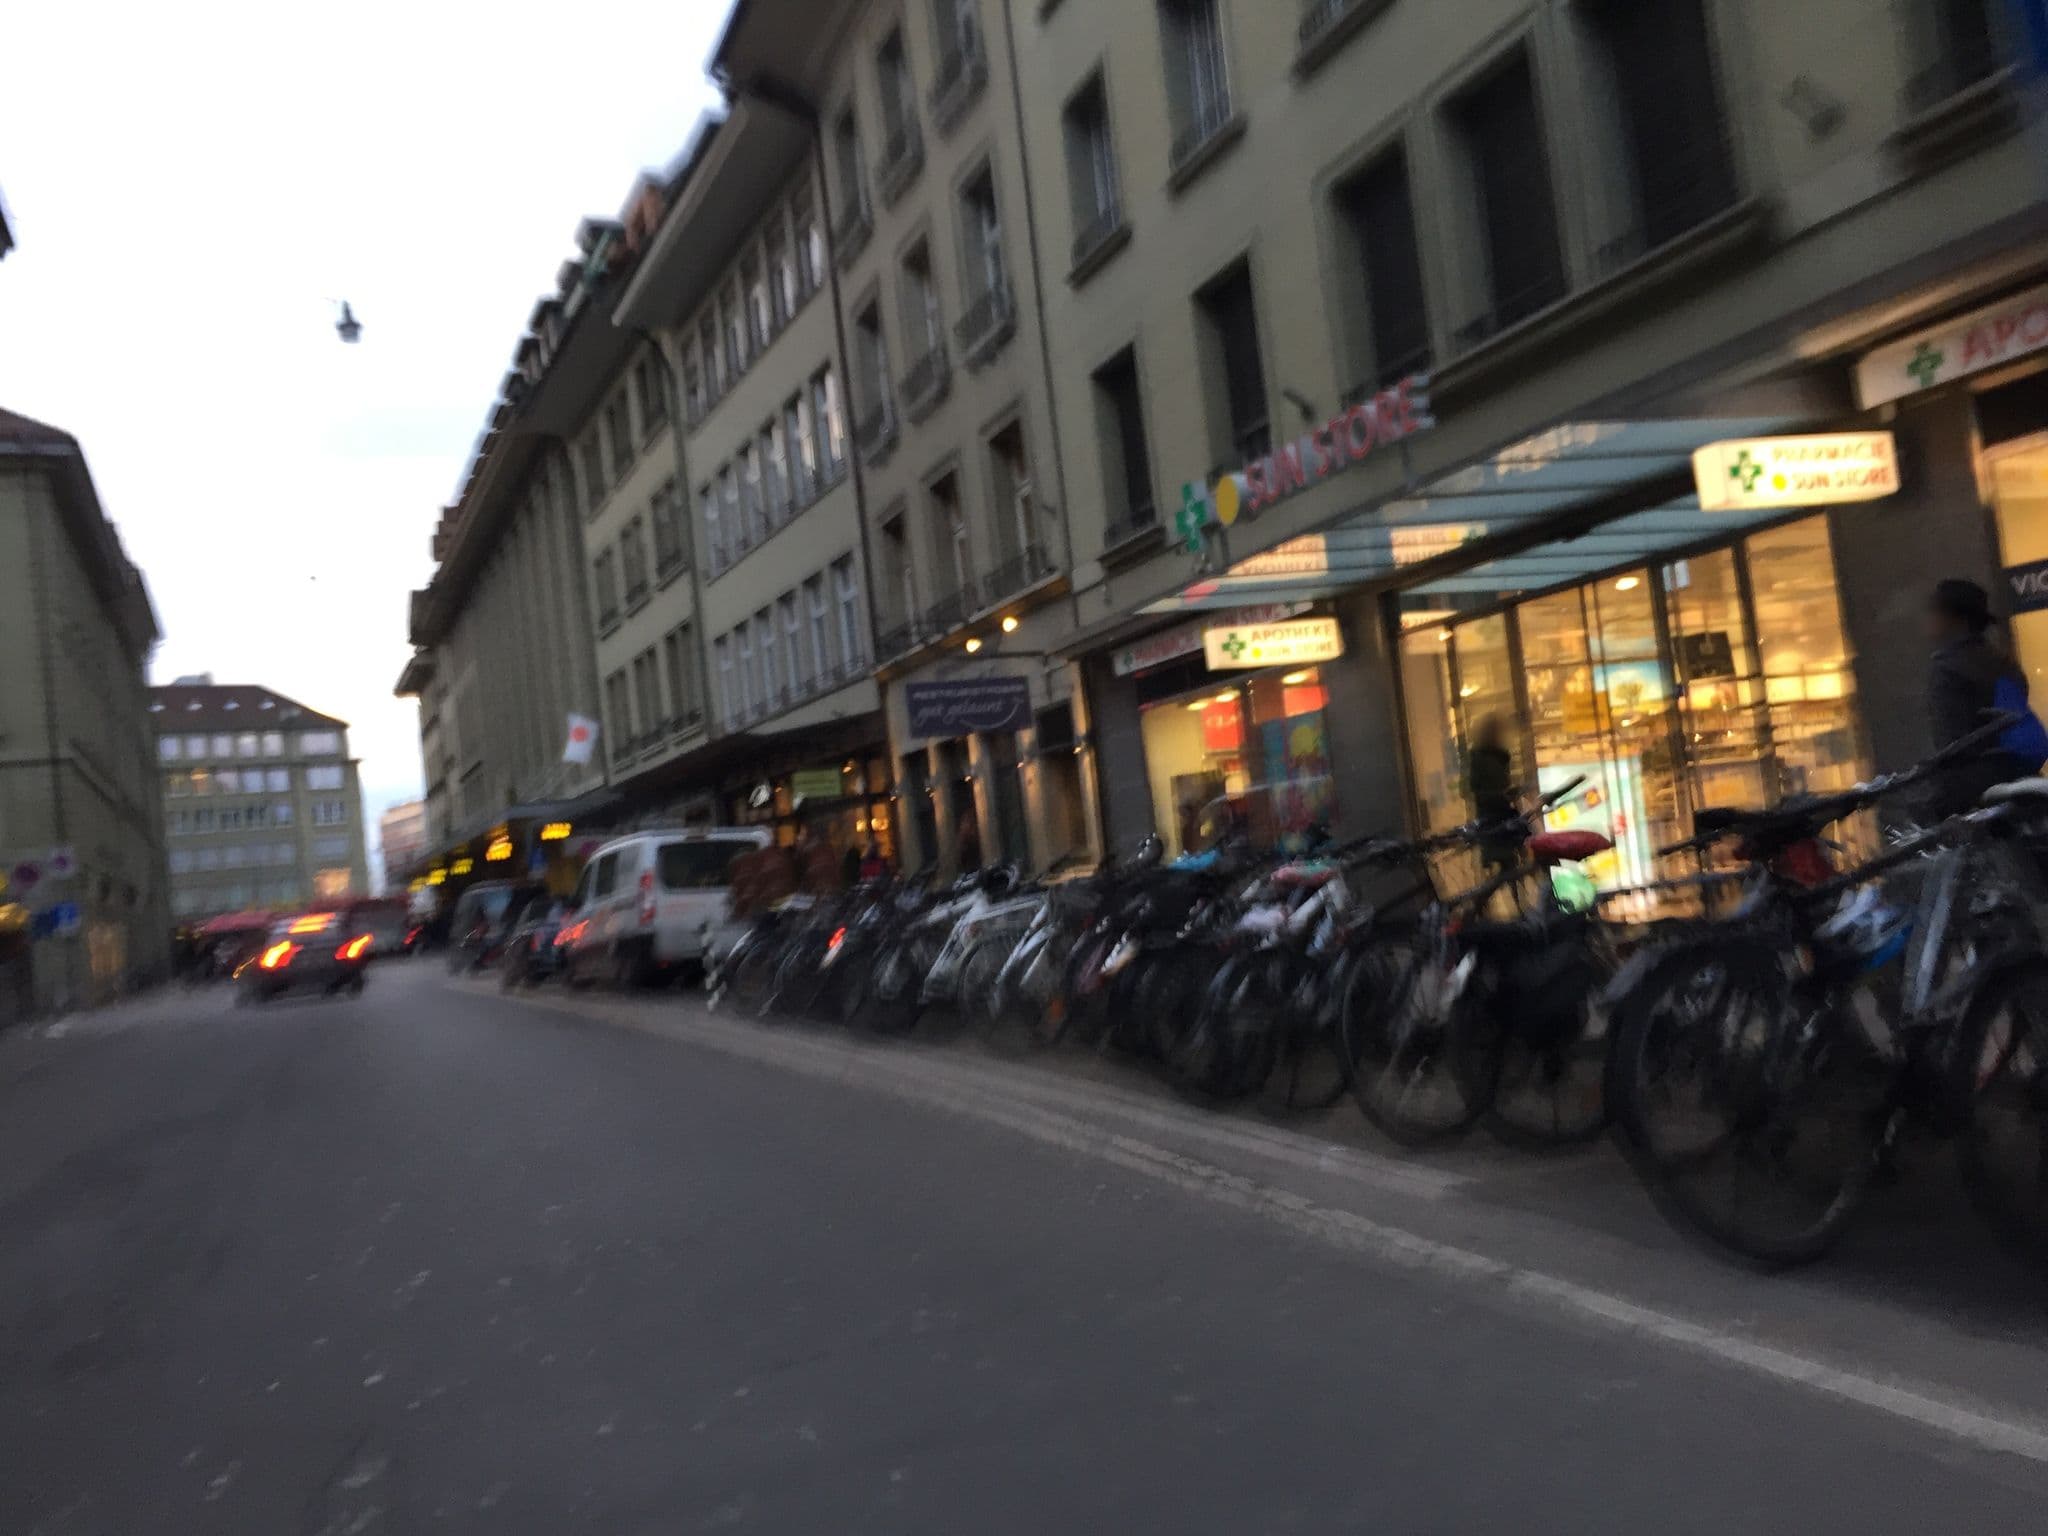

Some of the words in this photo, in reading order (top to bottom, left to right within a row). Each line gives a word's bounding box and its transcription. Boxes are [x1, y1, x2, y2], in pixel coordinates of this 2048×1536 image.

[1245, 440, 1307, 512] SUN
[1311, 374, 1434, 478] STORE
[1251, 623, 1332, 642] APOTHEKE
